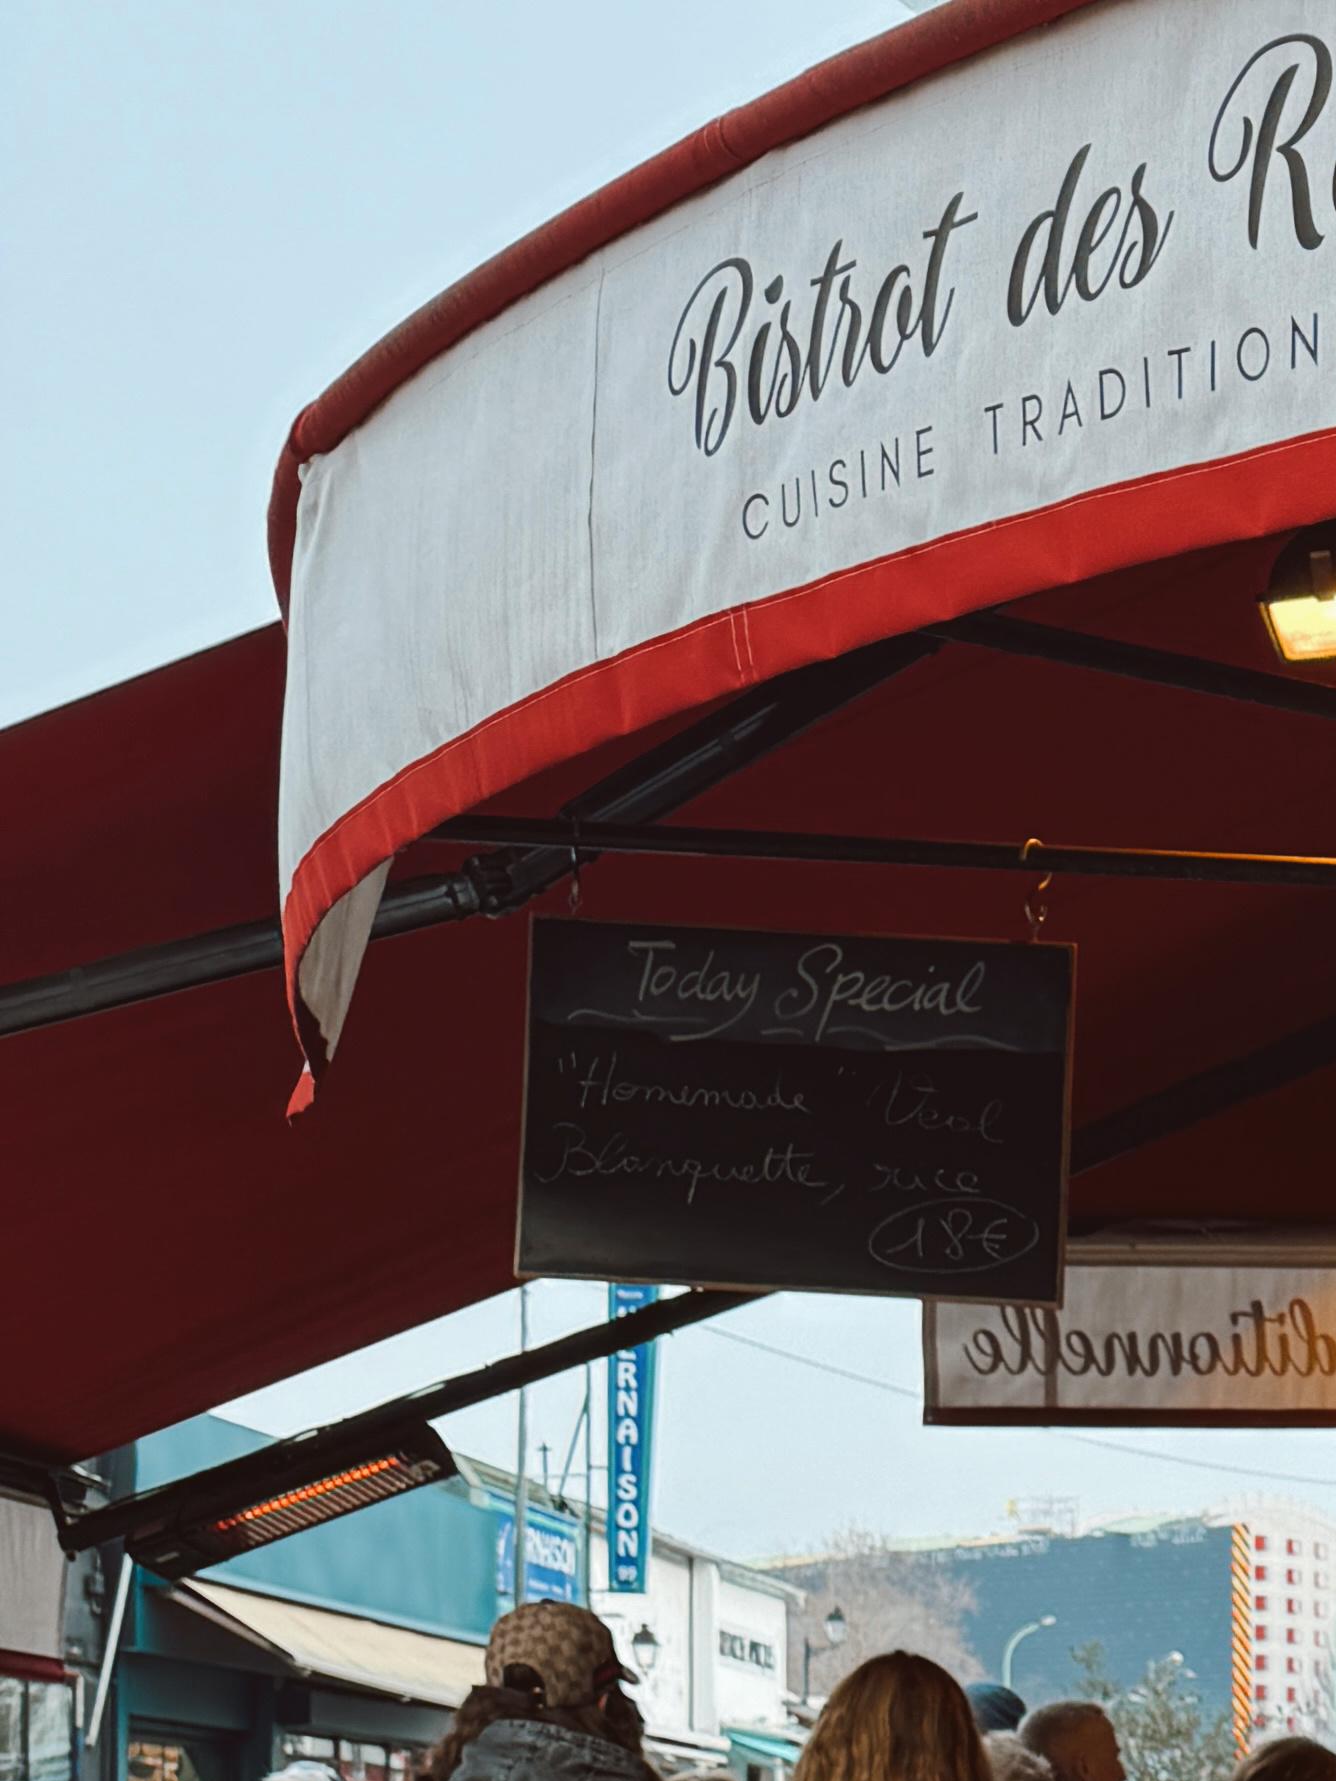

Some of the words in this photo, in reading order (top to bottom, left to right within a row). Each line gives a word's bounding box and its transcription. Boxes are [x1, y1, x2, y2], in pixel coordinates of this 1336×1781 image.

[667, 191, 979, 457] Bistrot
[1007, 143, 1177, 328] des
[741, 424, 936, 542] CUISINE
[627, 939, 762, 1042] Today
[773, 942, 986, 1042] Special
[881, 1069, 1004, 1144] Veal
[866, 1161, 982, 1195] rice
[887, 1208, 1009, 1260] 18€
[616, 1305, 640, 1558] RNAISON
